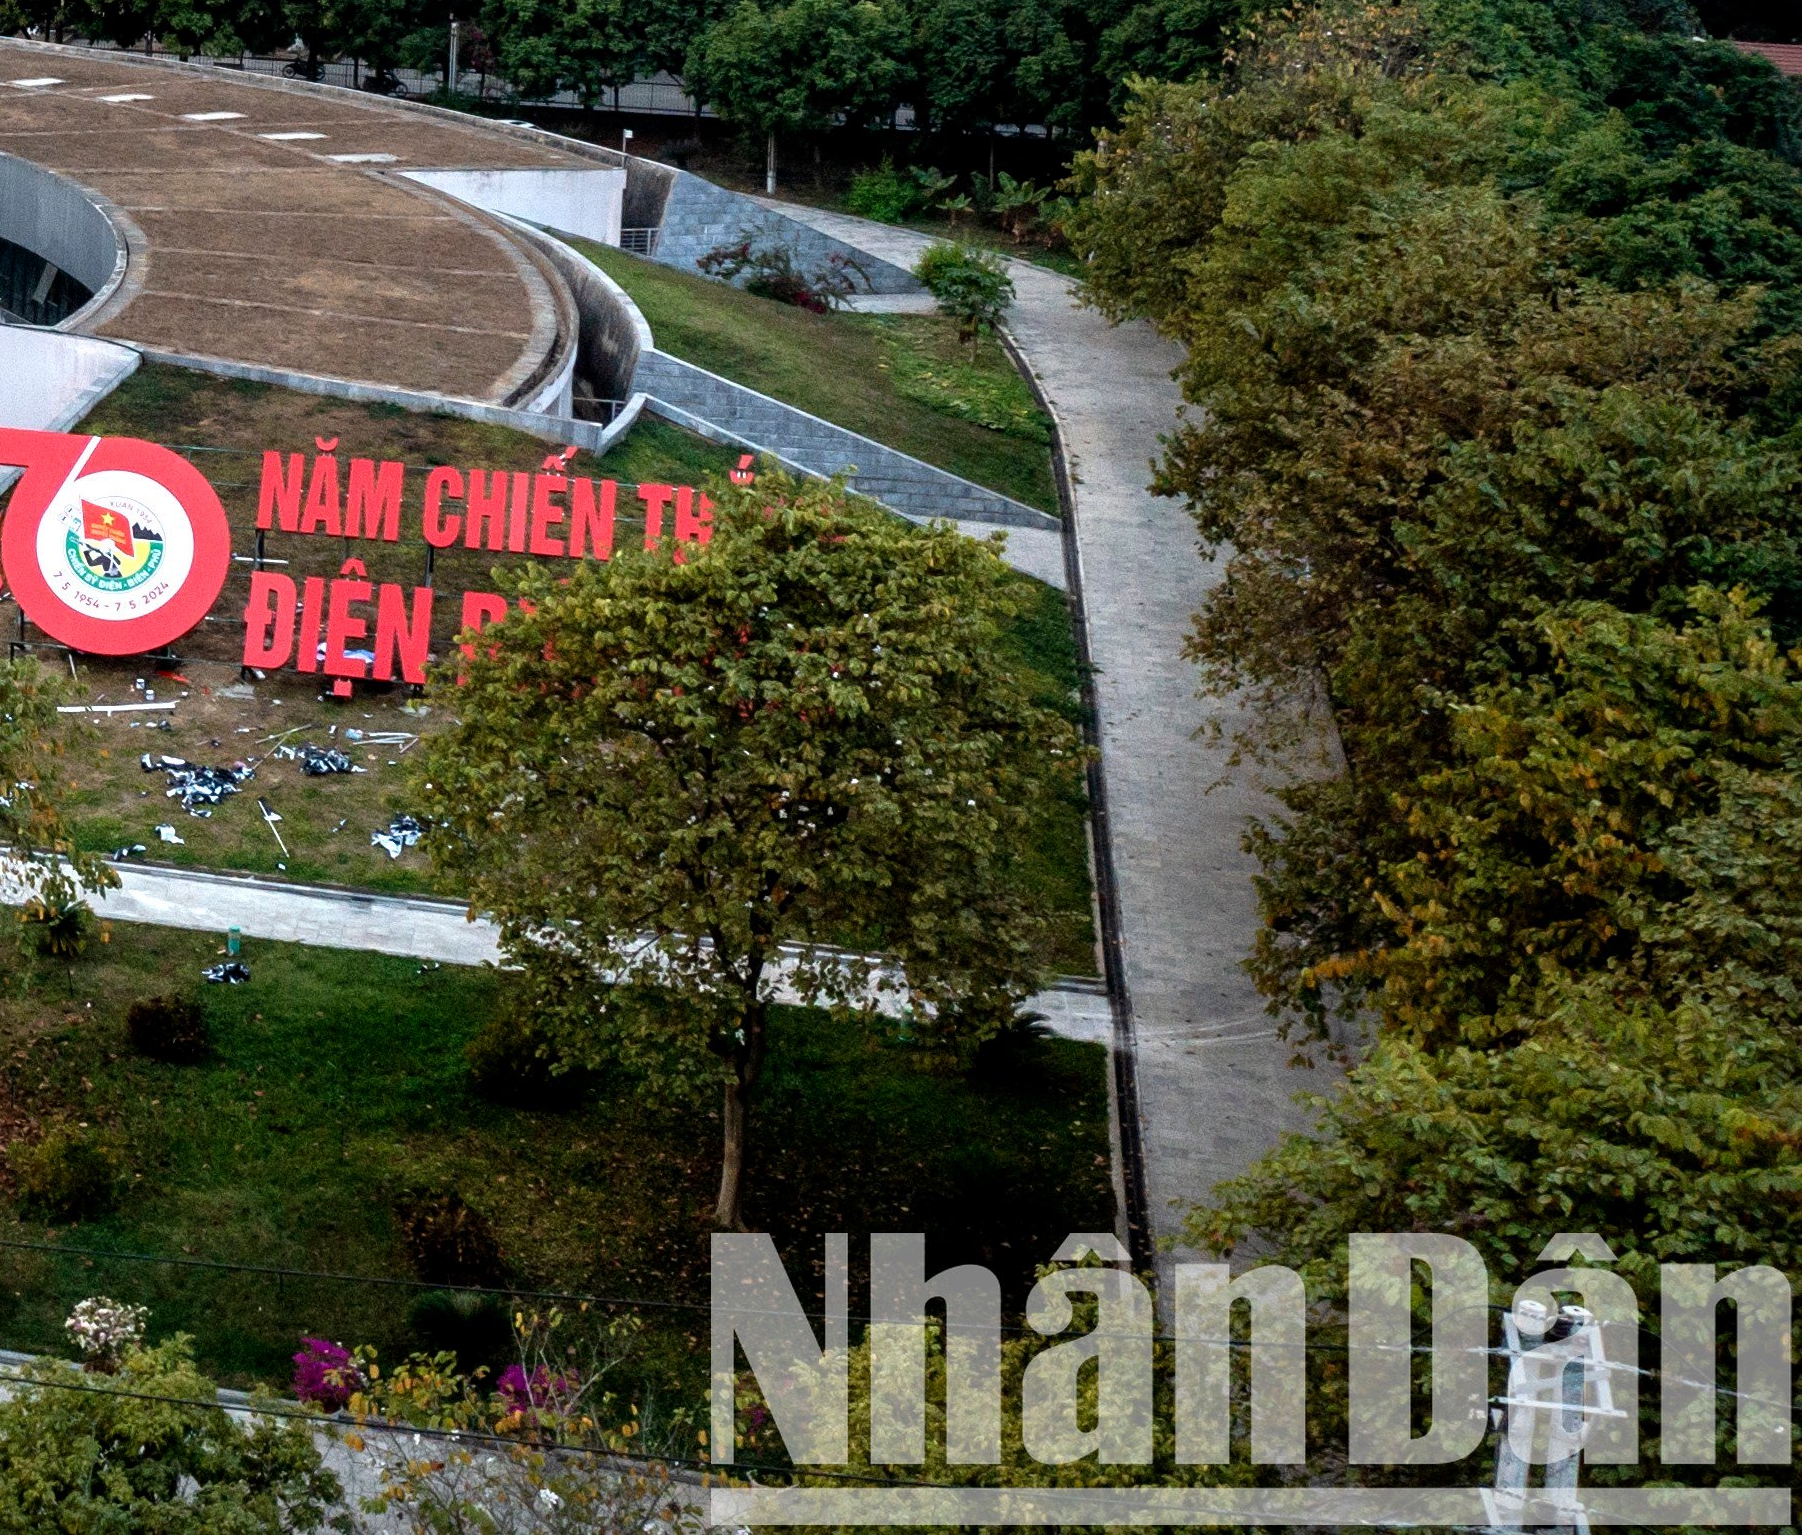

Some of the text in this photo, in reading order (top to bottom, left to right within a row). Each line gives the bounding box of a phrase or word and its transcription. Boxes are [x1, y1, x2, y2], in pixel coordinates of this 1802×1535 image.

[257, 436, 404, 542] NĂM
[423, 446, 617, 562] CHIẾN
[74, 591, 100, 609] 1954
[141, 581, 169, 604] 2024
[243, 558, 434, 699] ĐIỆN
